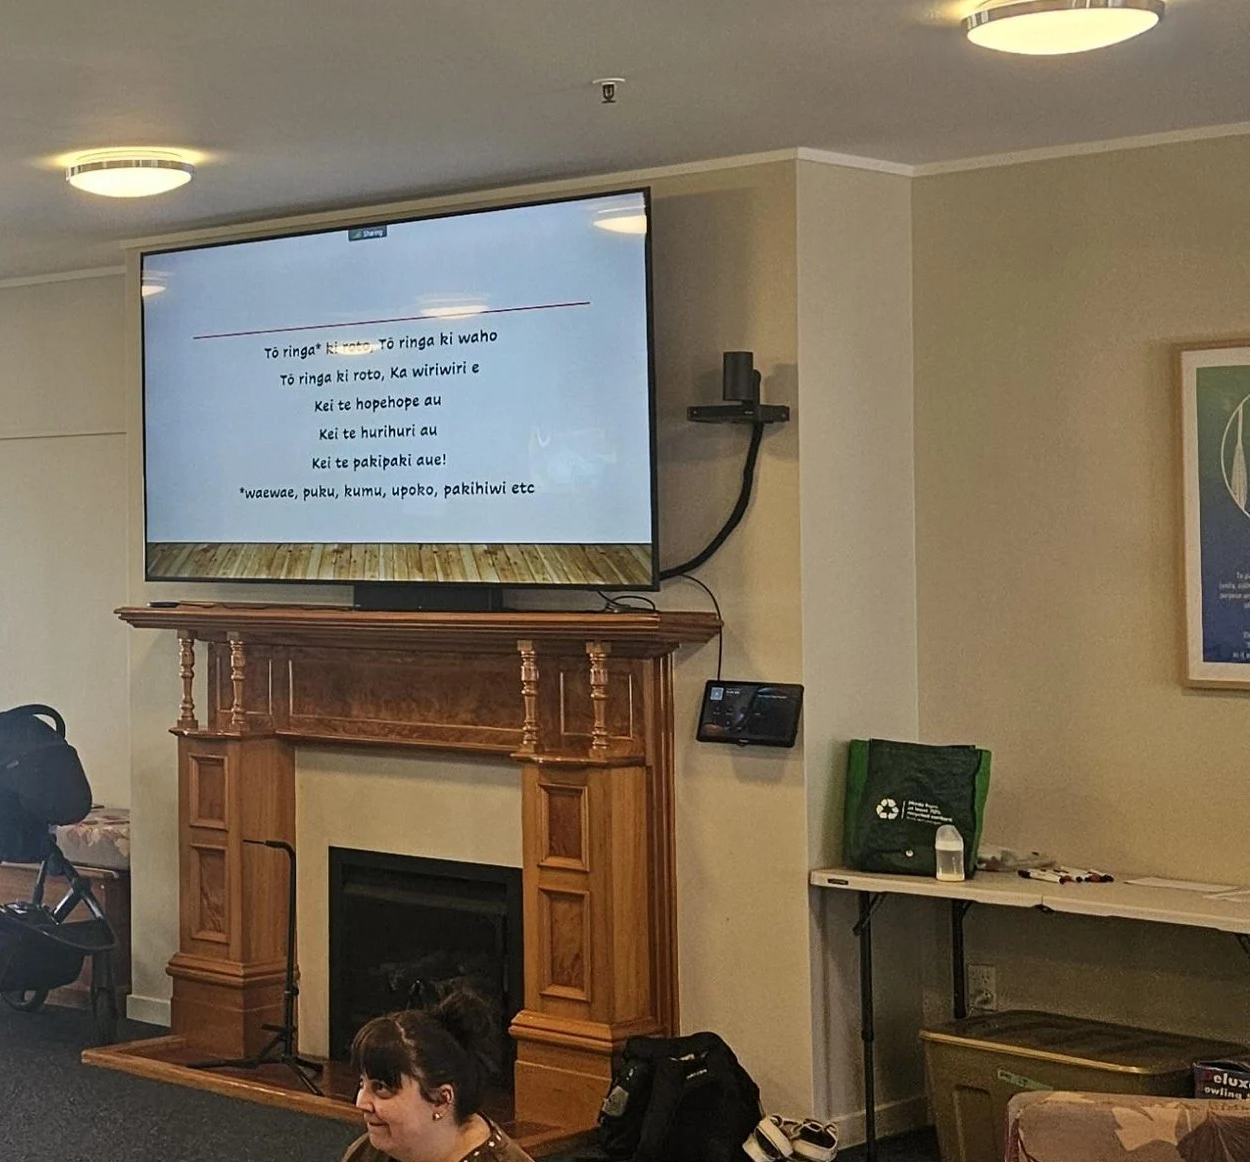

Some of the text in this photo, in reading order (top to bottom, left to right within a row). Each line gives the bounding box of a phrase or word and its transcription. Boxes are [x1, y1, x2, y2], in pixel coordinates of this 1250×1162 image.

[264, 346, 279, 359] Tō
[326, 341, 338, 355] ki
[343, 341, 374, 354] roto,
[378, 336, 394, 350] Tō
[399, 335, 435, 350] ringa
[440, 332, 453, 346] ki
[458, 329, 498, 344] waho
[280, 361, 480, 387] Tō ringa ki roto, Ka wiriwiri e
[314, 396, 441, 413] Kei te hopehope au
[319, 424, 437, 440] Kei te hurihuri au
[312, 453, 446, 472] Kei te pakipaki aue!
[303, 485, 339, 501] puku,
[344, 484, 387, 499] kumu,
[392, 483, 438, 500] upoko,
[444, 481, 506, 499] pakihiwi
[511, 483, 535, 494] etc
[1203, 1086, 1243, 1100] owling
